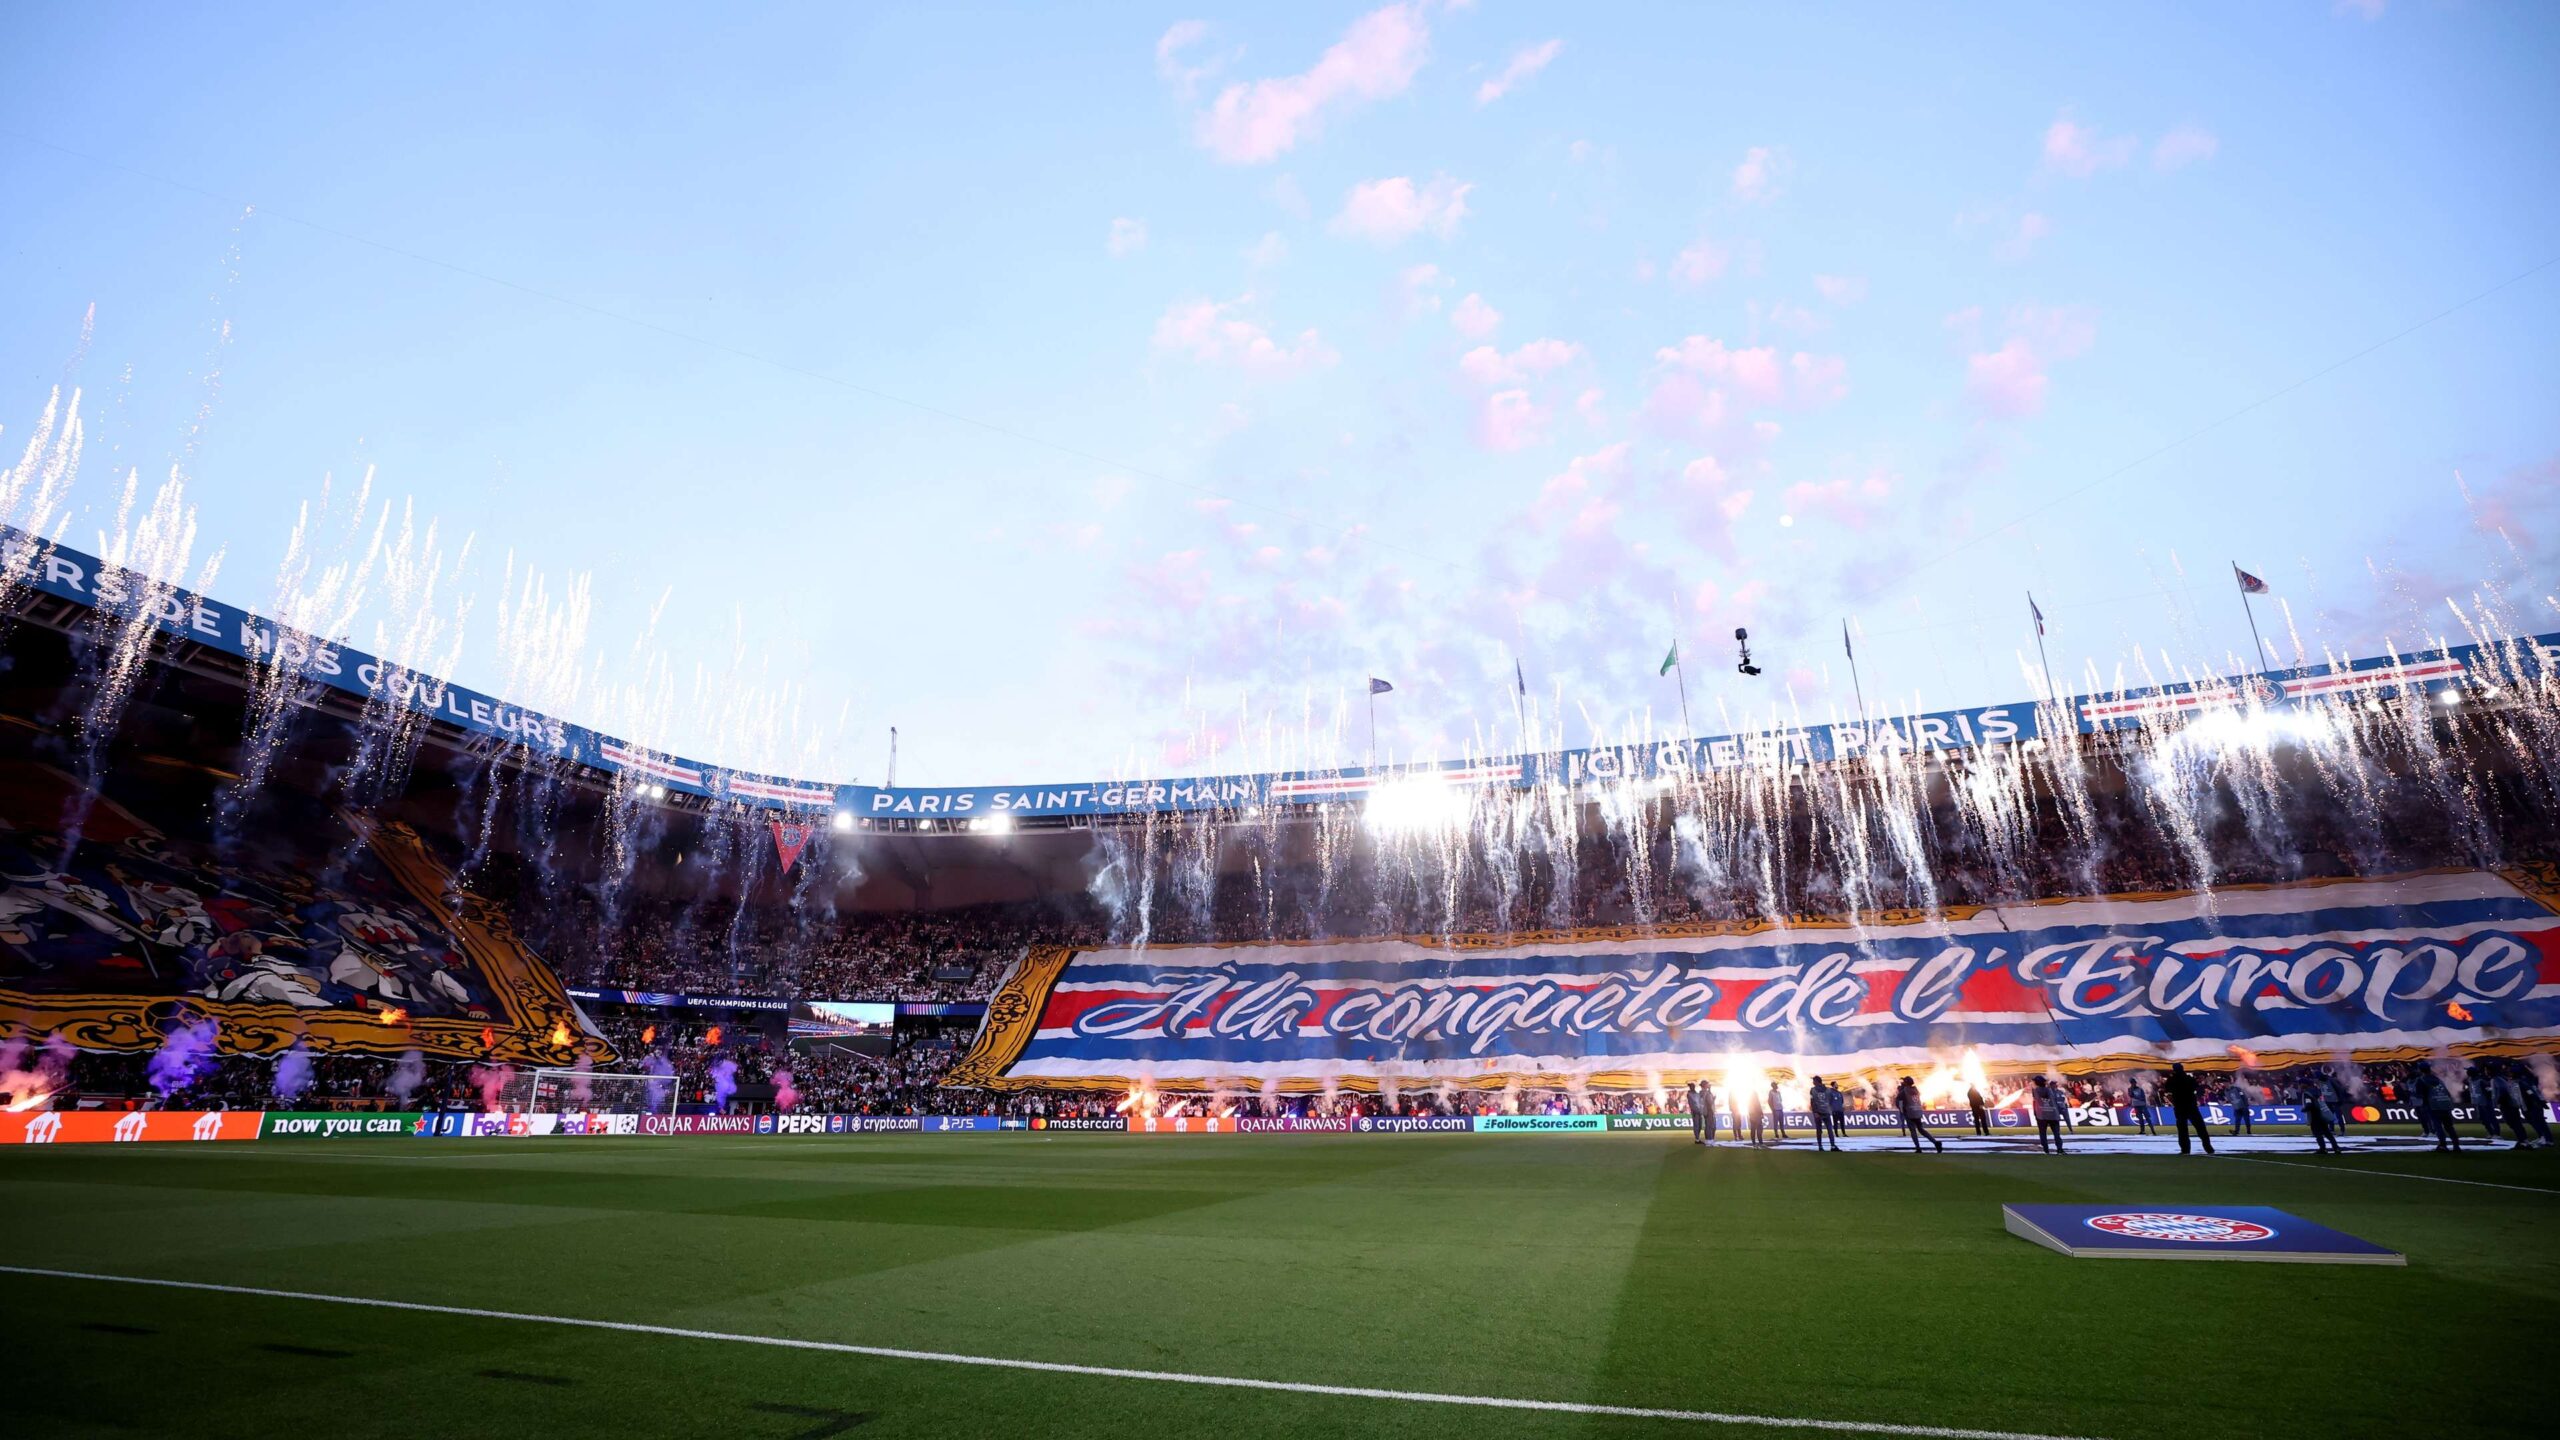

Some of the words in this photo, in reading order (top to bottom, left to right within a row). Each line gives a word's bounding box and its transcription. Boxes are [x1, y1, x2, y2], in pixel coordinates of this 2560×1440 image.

[153, 587, 222, 638] DE
[241, 621, 342, 676] NOS
[357, 663, 568, 748] COULEURS
[1836, 709, 2019, 747] PARIS
[872, 793, 974, 813] PARIS
[990, 782, 1250, 810] SAINT-GERMAIN
[687, 997, 707, 1006] UEFA
[709, 999, 757, 1008] CHAMPIONS
[758, 1001, 788, 1010] LEAGUE
[1216, 971, 1313, 1039] la
[1329, 962, 1713, 1055] conquête
[1745, 952, 1861, 1029] de
[471, 1113, 534, 1136] FedEx
[645, 1116, 692, 1133] QATAR
[697, 1116, 750, 1132] AIRWAYS
[777, 1115, 827, 1133] PEPSI
[863, 1117, 918, 1132] crypto.com
[951, 1118, 974, 1129] PS5
[1050, 1116, 1124, 1129] mastercard
[1377, 1116, 1466, 1132] crypto.com
[1490, 1118, 1598, 1129] FollowScores.com
[1613, 1118, 1644, 1128] now
[1646, 1118, 1671, 1130] you
[1904, 1113, 1958, 1126] AGUE
[2028, 1107, 2120, 1126] PSI
[272, 1118, 321, 1134] now
[322, 1118, 362, 1137] you
[366, 1117, 402, 1133] can
[1240, 1118, 1285, 1133] QATAR
[1290, 1118, 1347, 1131] AIRWAYS
